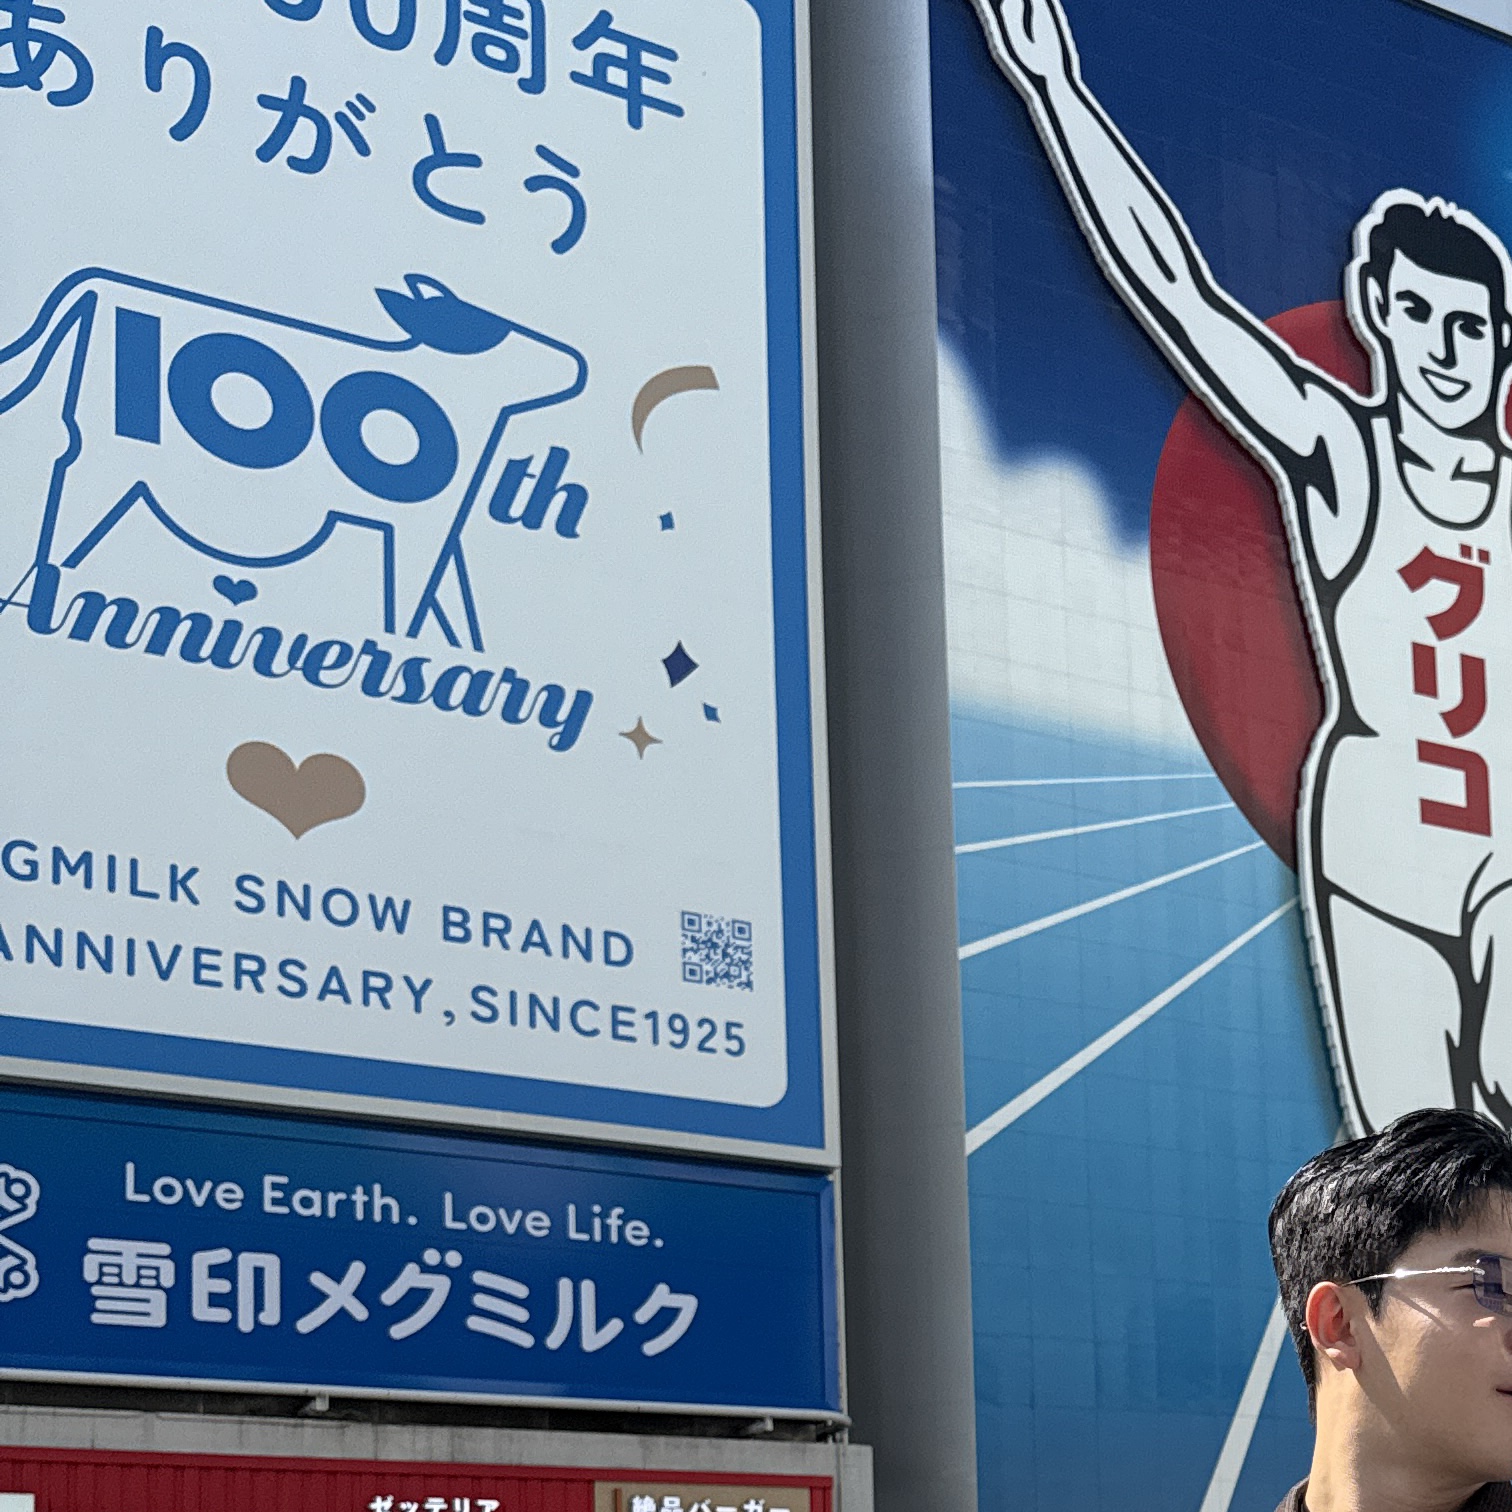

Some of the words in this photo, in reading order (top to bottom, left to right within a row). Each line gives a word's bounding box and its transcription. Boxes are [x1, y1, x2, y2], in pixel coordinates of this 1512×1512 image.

[0, 0, 588, 255] ありがとう
[0, 561, 595, 753] Anniversary
[1397, 543, 1492, 838] グリコ
[1, 839, 200, 906] GMILK
[234, 873, 412, 936] SNOW
[442, 903, 636, 968] BRAND
[0, 920, 747, 1058] NNIVERSARY,SINCE1925
[125, 1160, 245, 1210] Love
[263, 1175, 419, 1226] Earth.
[443, 1192, 552, 1238] Love
[567, 1203, 666, 1248] Life.
[82, 1237, 699, 1358] 雪印メグミルク
